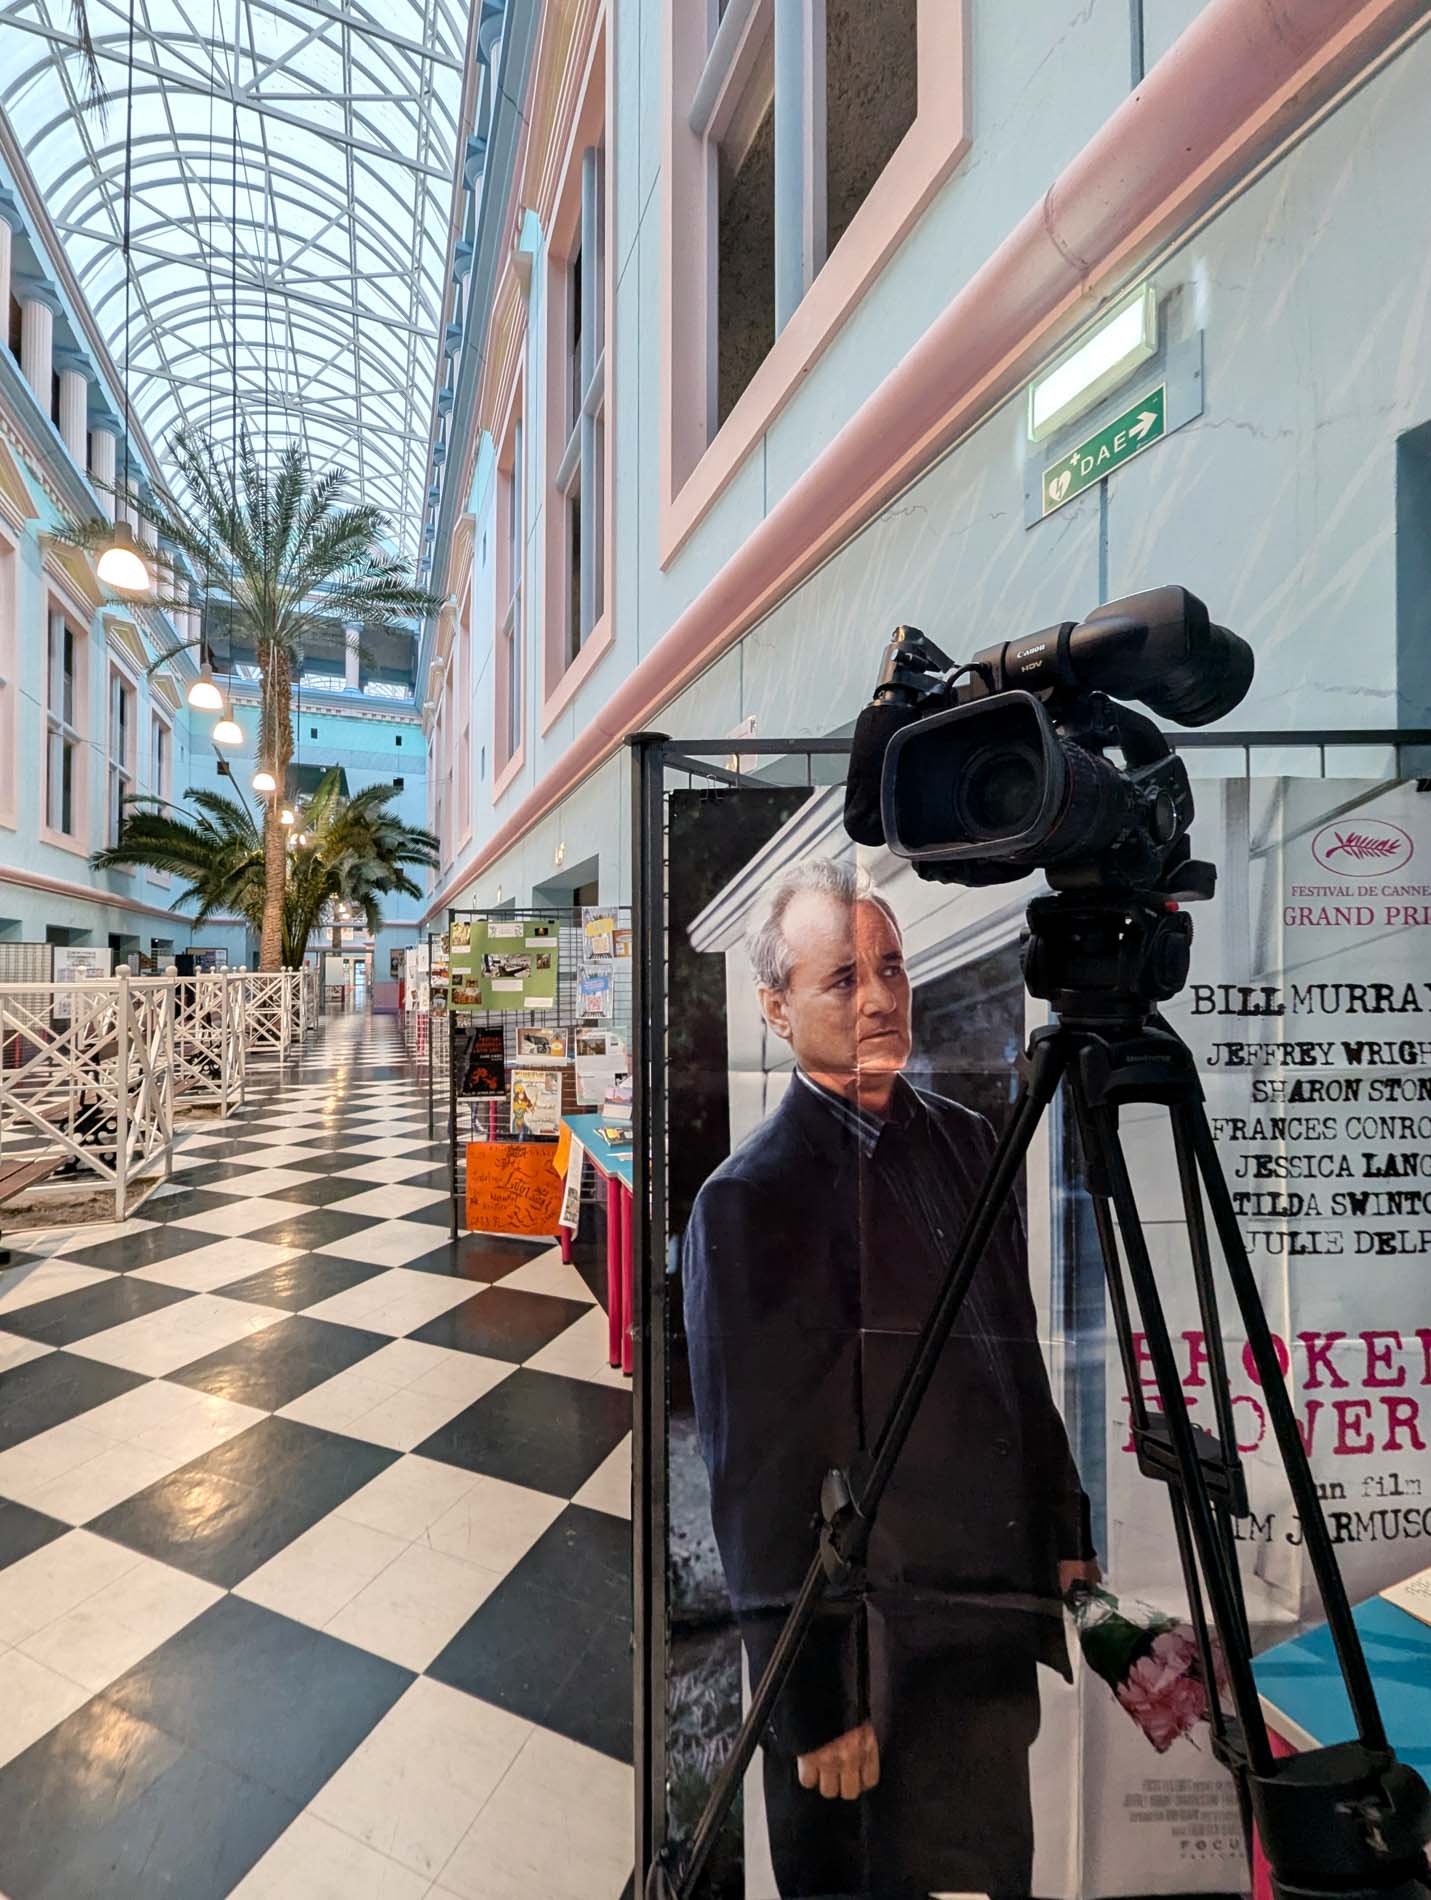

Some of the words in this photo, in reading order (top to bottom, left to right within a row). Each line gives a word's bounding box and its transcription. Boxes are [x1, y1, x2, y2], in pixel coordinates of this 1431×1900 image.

[1080, 430, 1128, 477] DAE
[1021, 660, 1044, 673] HDV
[1291, 885, 1354, 897] FESTIVAL
[1357, 885, 1379, 897] DE
[1381, 885, 1431, 897] CANNE
[1283, 905, 1375, 926] GRAND
[1190, 984, 1286, 1017] BILL
[1206, 1041, 1335, 1067] JEFFREY
[1252, 1079, 1363, 1103] SHARON
[1211, 1117, 1337, 1141] FRANCES
[1235, 1154, 1354, 1179] JESSICA
[1233, 1191, 1322, 1217] TILDA
[1245, 1230, 1344, 1255] JULIE
[1361, 1472, 1422, 1498] film
